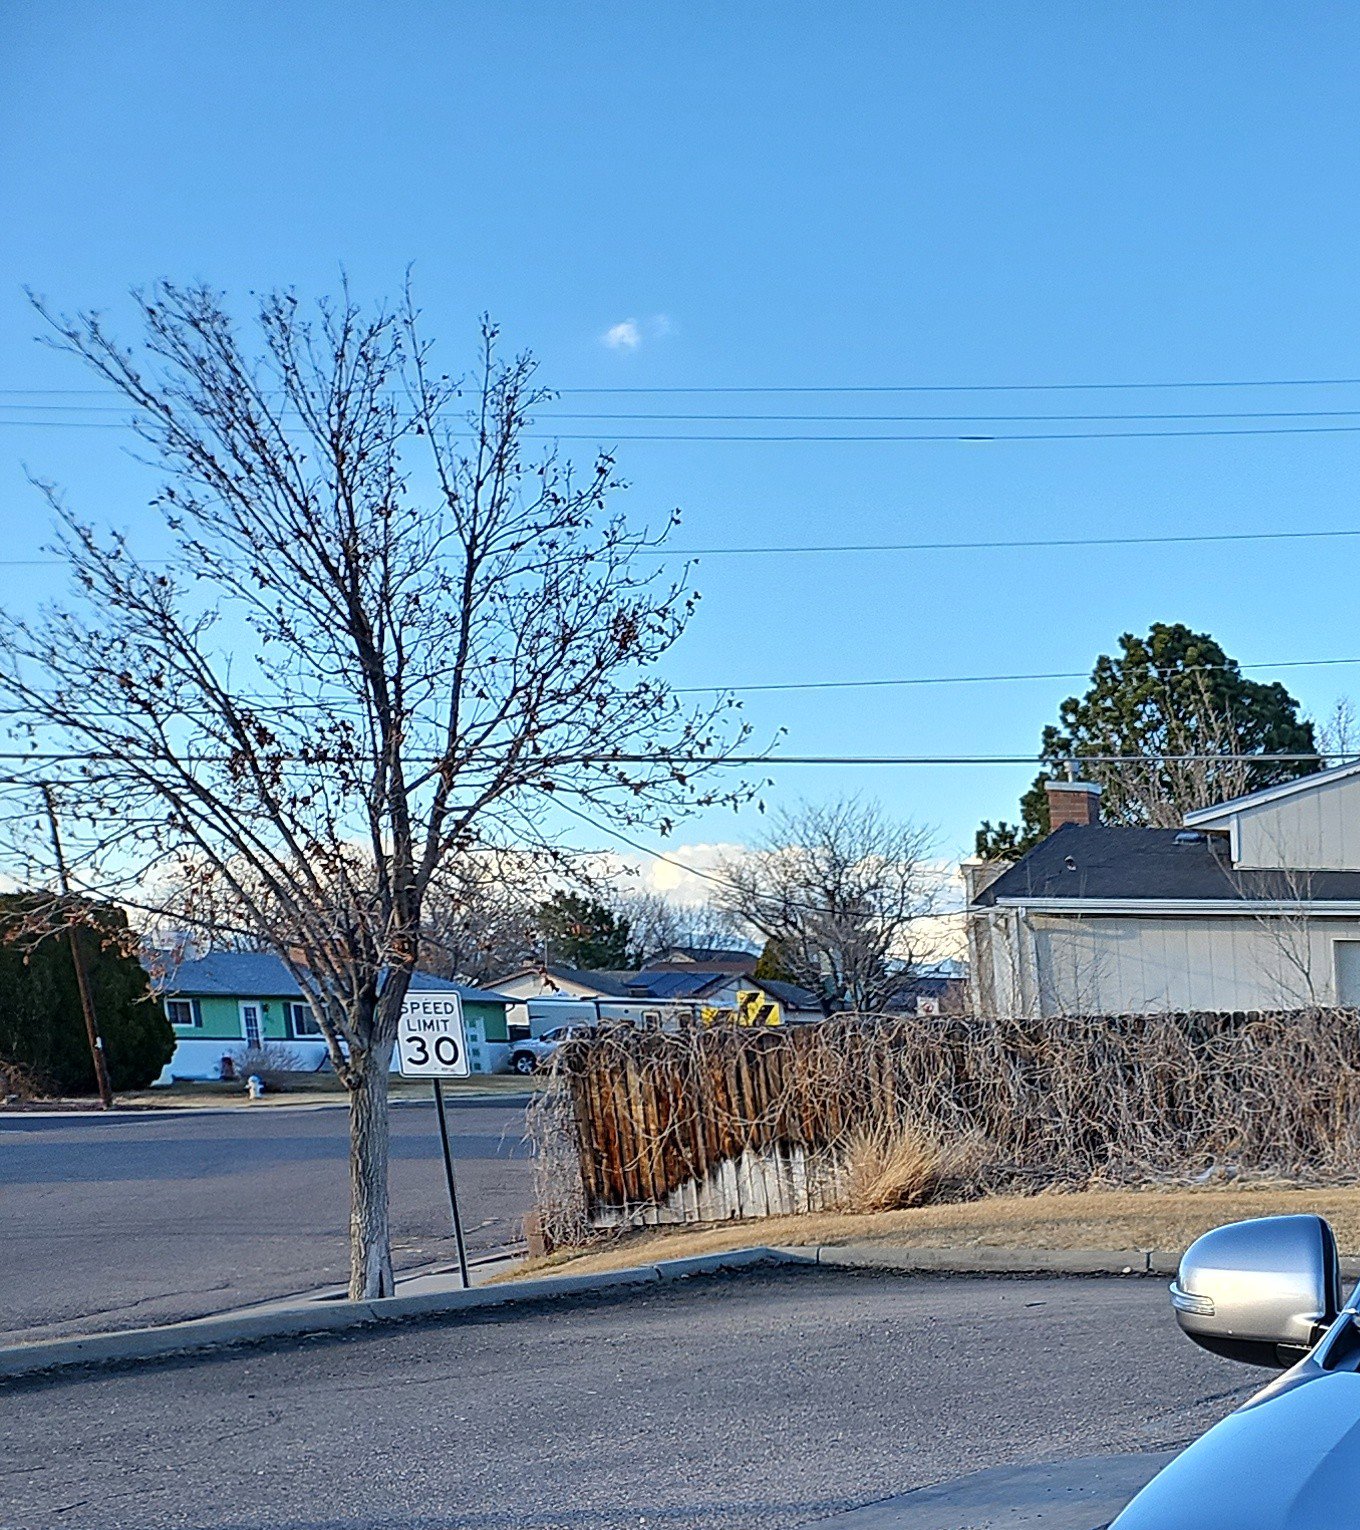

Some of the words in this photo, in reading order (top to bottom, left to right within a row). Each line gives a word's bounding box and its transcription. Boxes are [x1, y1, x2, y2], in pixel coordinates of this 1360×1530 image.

[401, 1002, 454, 1015] SPEED
[406, 1019, 450, 1032] LIMIT
[405, 1036, 460, 1066] 30
